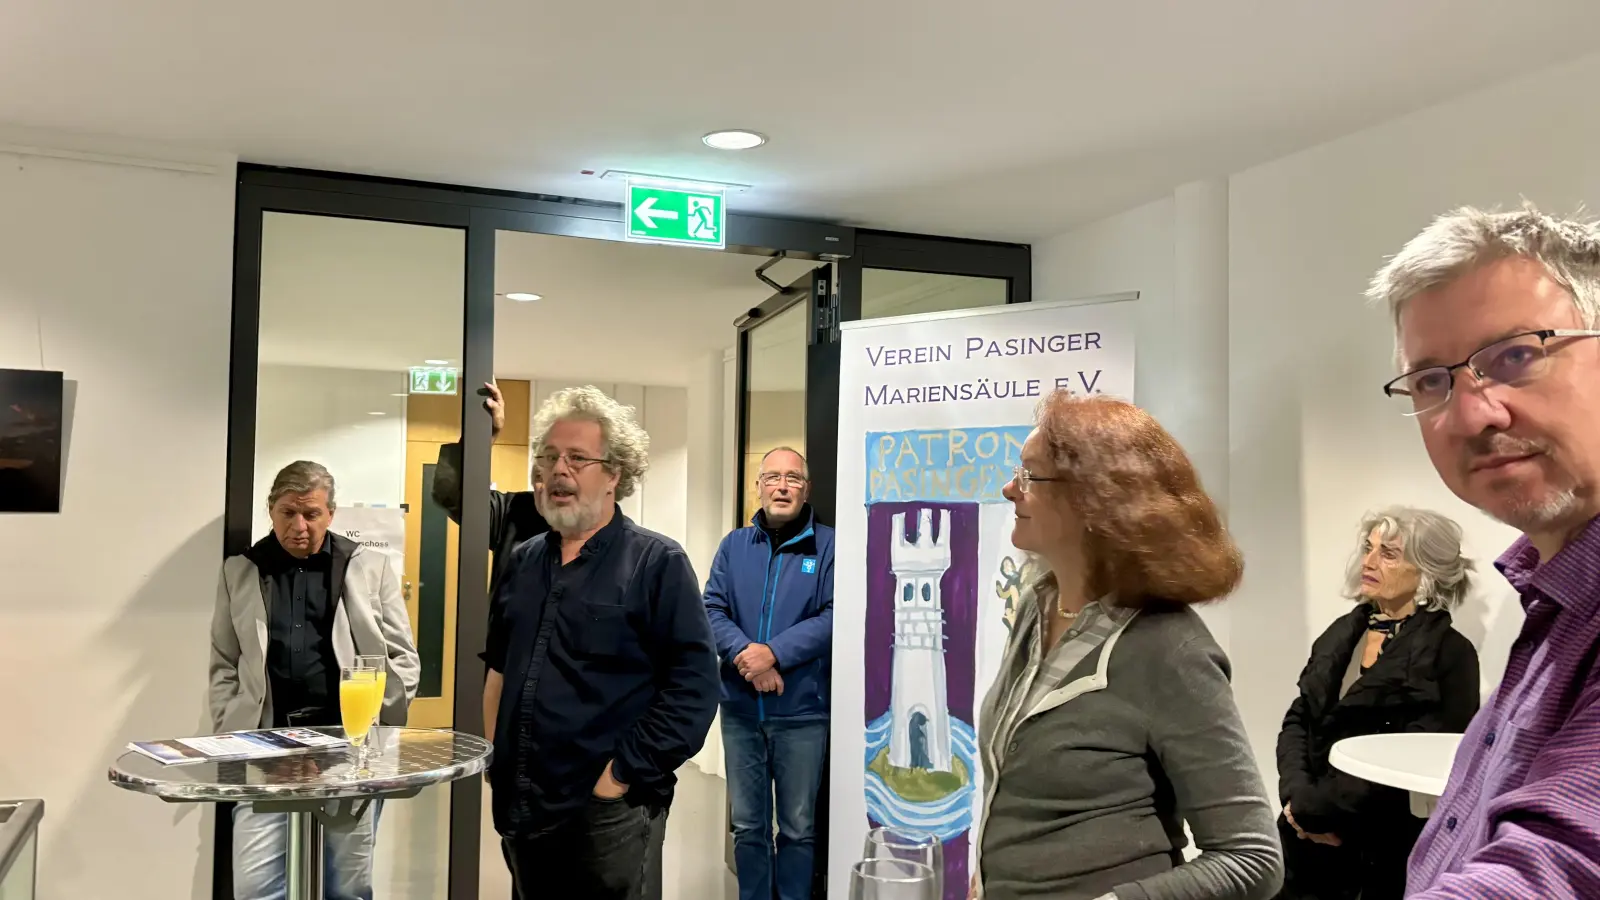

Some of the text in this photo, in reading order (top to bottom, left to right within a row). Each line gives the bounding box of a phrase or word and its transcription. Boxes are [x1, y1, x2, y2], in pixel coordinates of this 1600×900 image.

[865, 331, 1102, 367] VEREIN PASINGER
[864, 378, 1041, 406] MARIENSÄULE
[345, 530, 361, 538] WC
[361, 540, 389, 548] schoss
